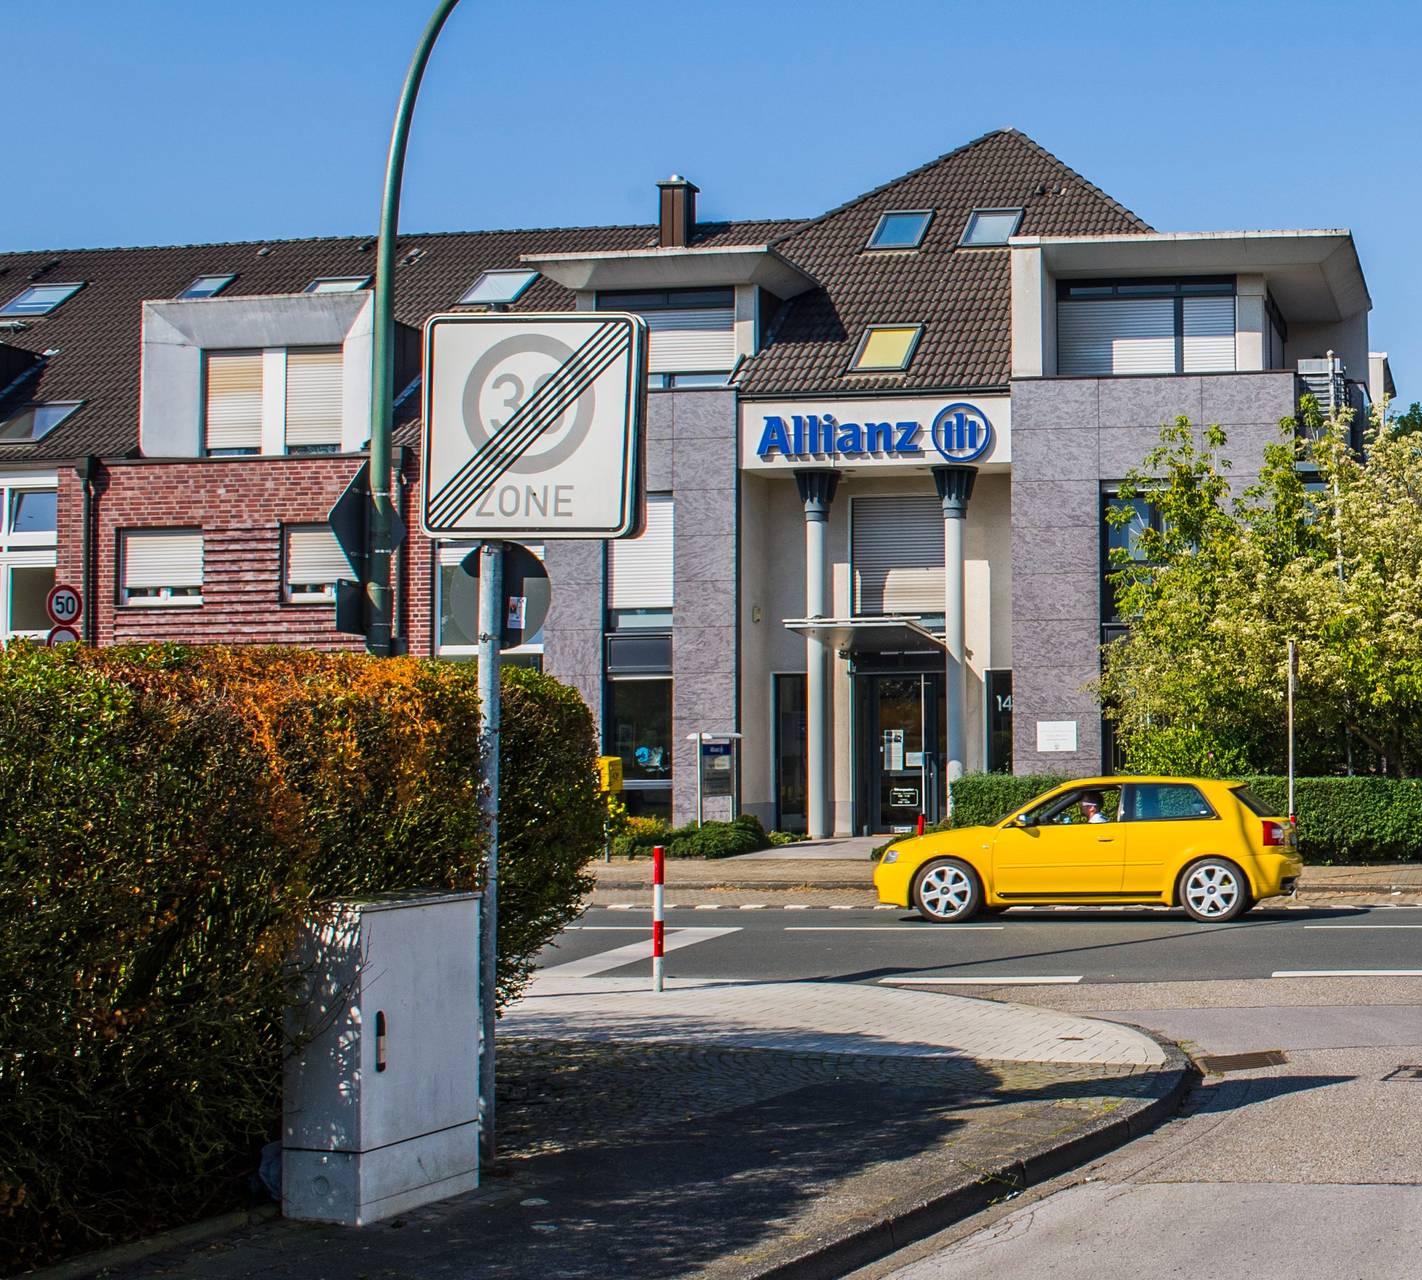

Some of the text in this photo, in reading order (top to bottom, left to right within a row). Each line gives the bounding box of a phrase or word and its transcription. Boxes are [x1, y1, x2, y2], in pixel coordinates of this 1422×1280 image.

[490, 373, 566, 434] 30
[757, 414, 922, 455] Allianz
[475, 485, 574, 517] ZONE
[55, 596, 75, 614] 50
